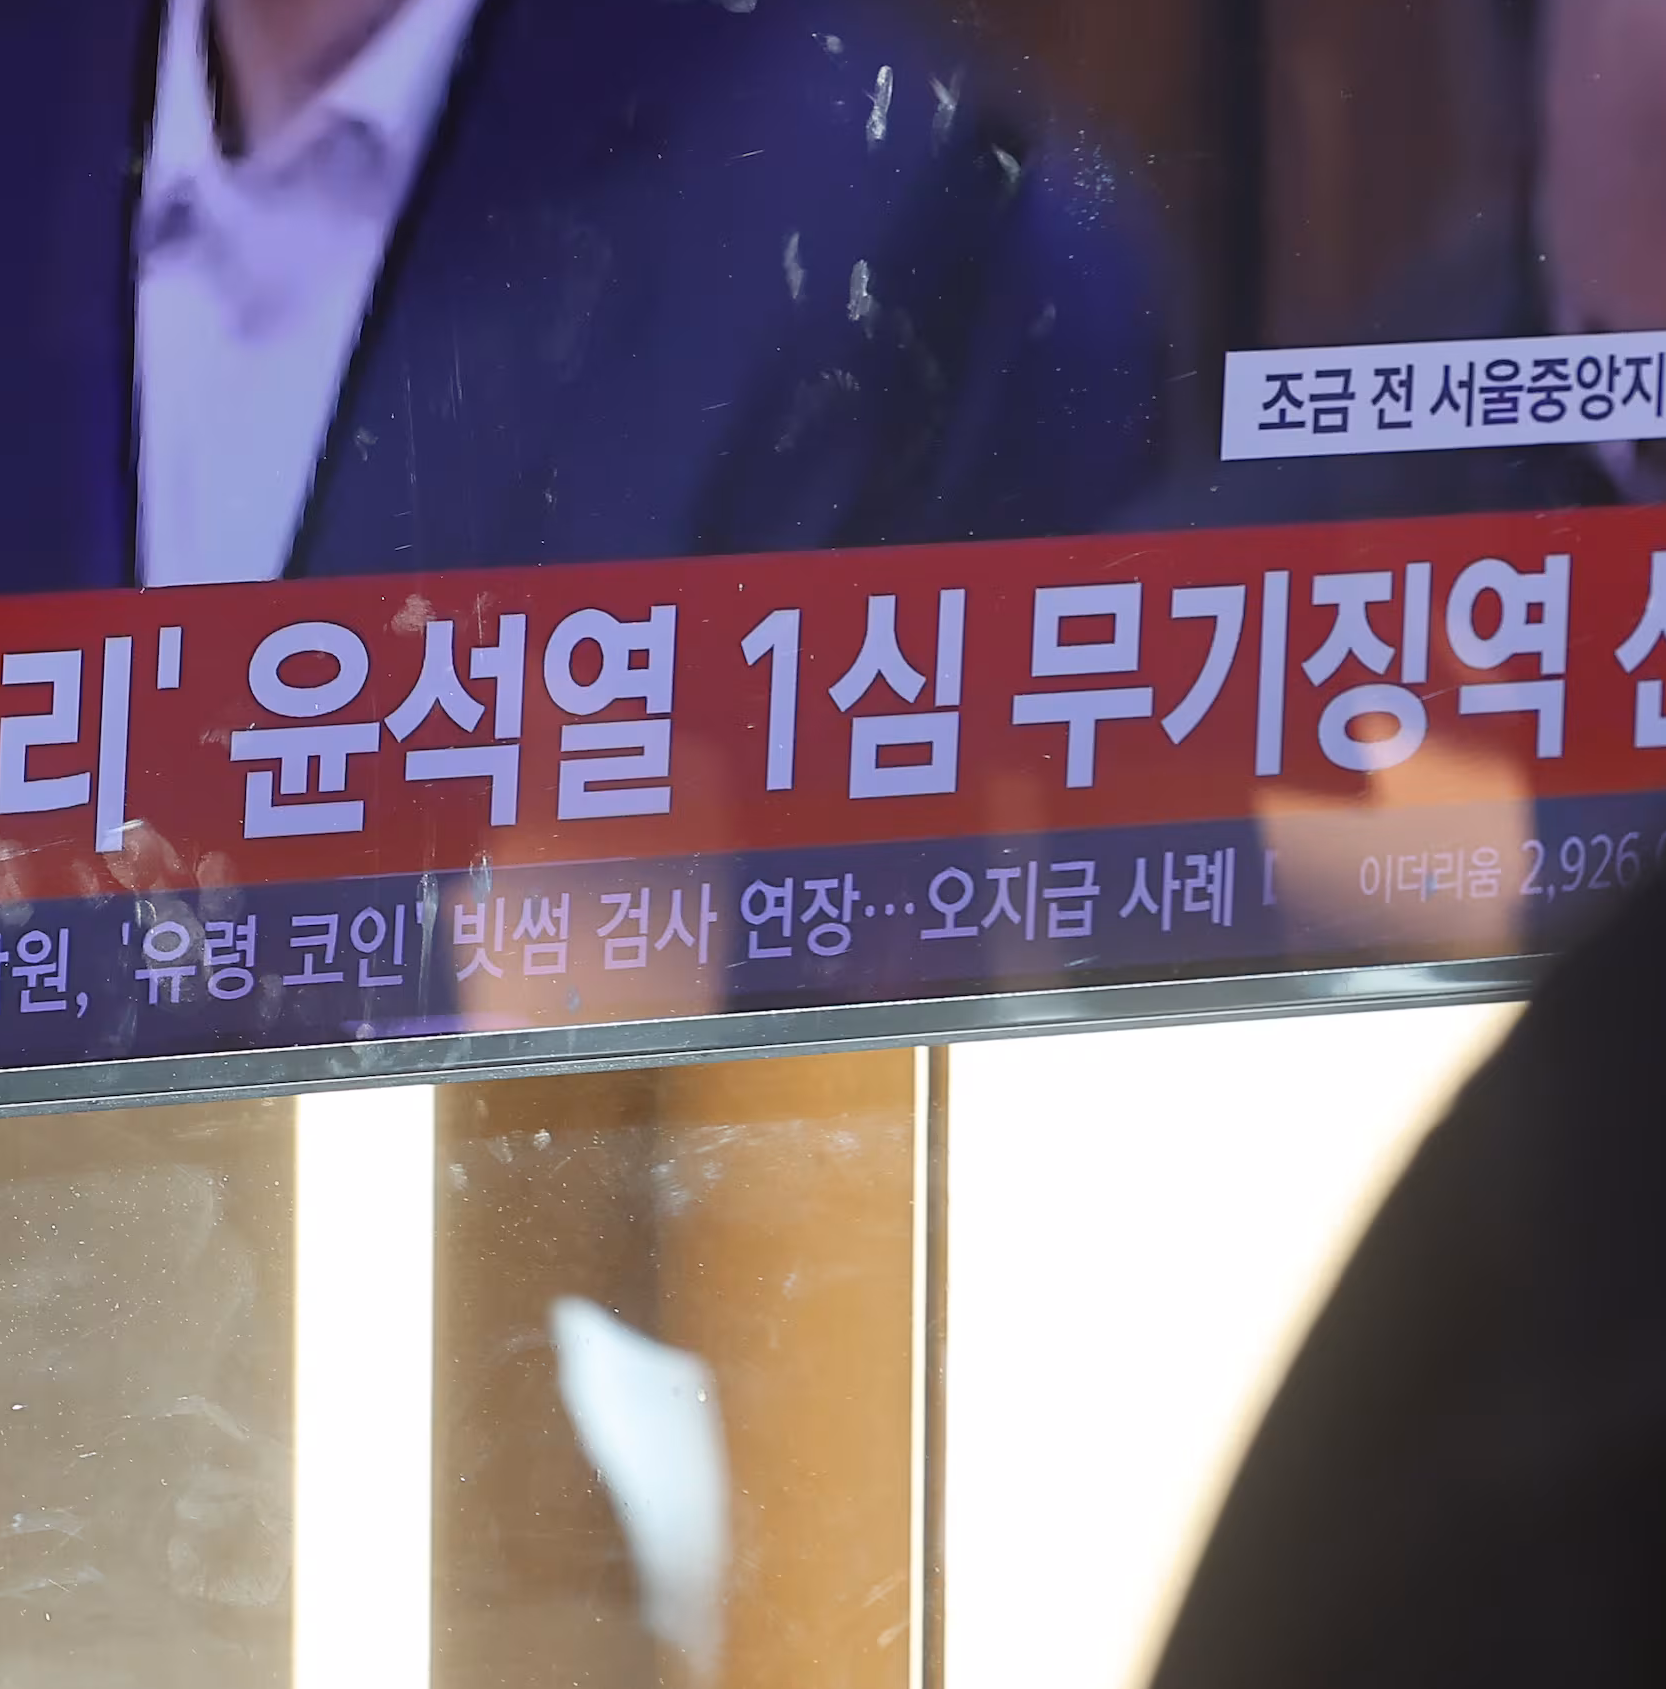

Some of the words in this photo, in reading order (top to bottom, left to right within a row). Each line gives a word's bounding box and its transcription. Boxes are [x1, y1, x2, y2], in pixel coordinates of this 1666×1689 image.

[1258, 368, 1356, 434] 조금
[1371, 363, 1414, 430] 전
[229, 603, 678, 840] 윤석열
[740, 586, 967, 800] 1심
[1011, 552, 1572, 789] 무기징역
[121, 913, 258, 1006] '유령
[282, 902, 425, 989] 코인'
[452, 892, 571, 983] 빗썸
[596, 883, 718, 972] 검사
[1120, 846, 1236, 931] 사례
[1359, 846, 1502, 904] 이더리움
